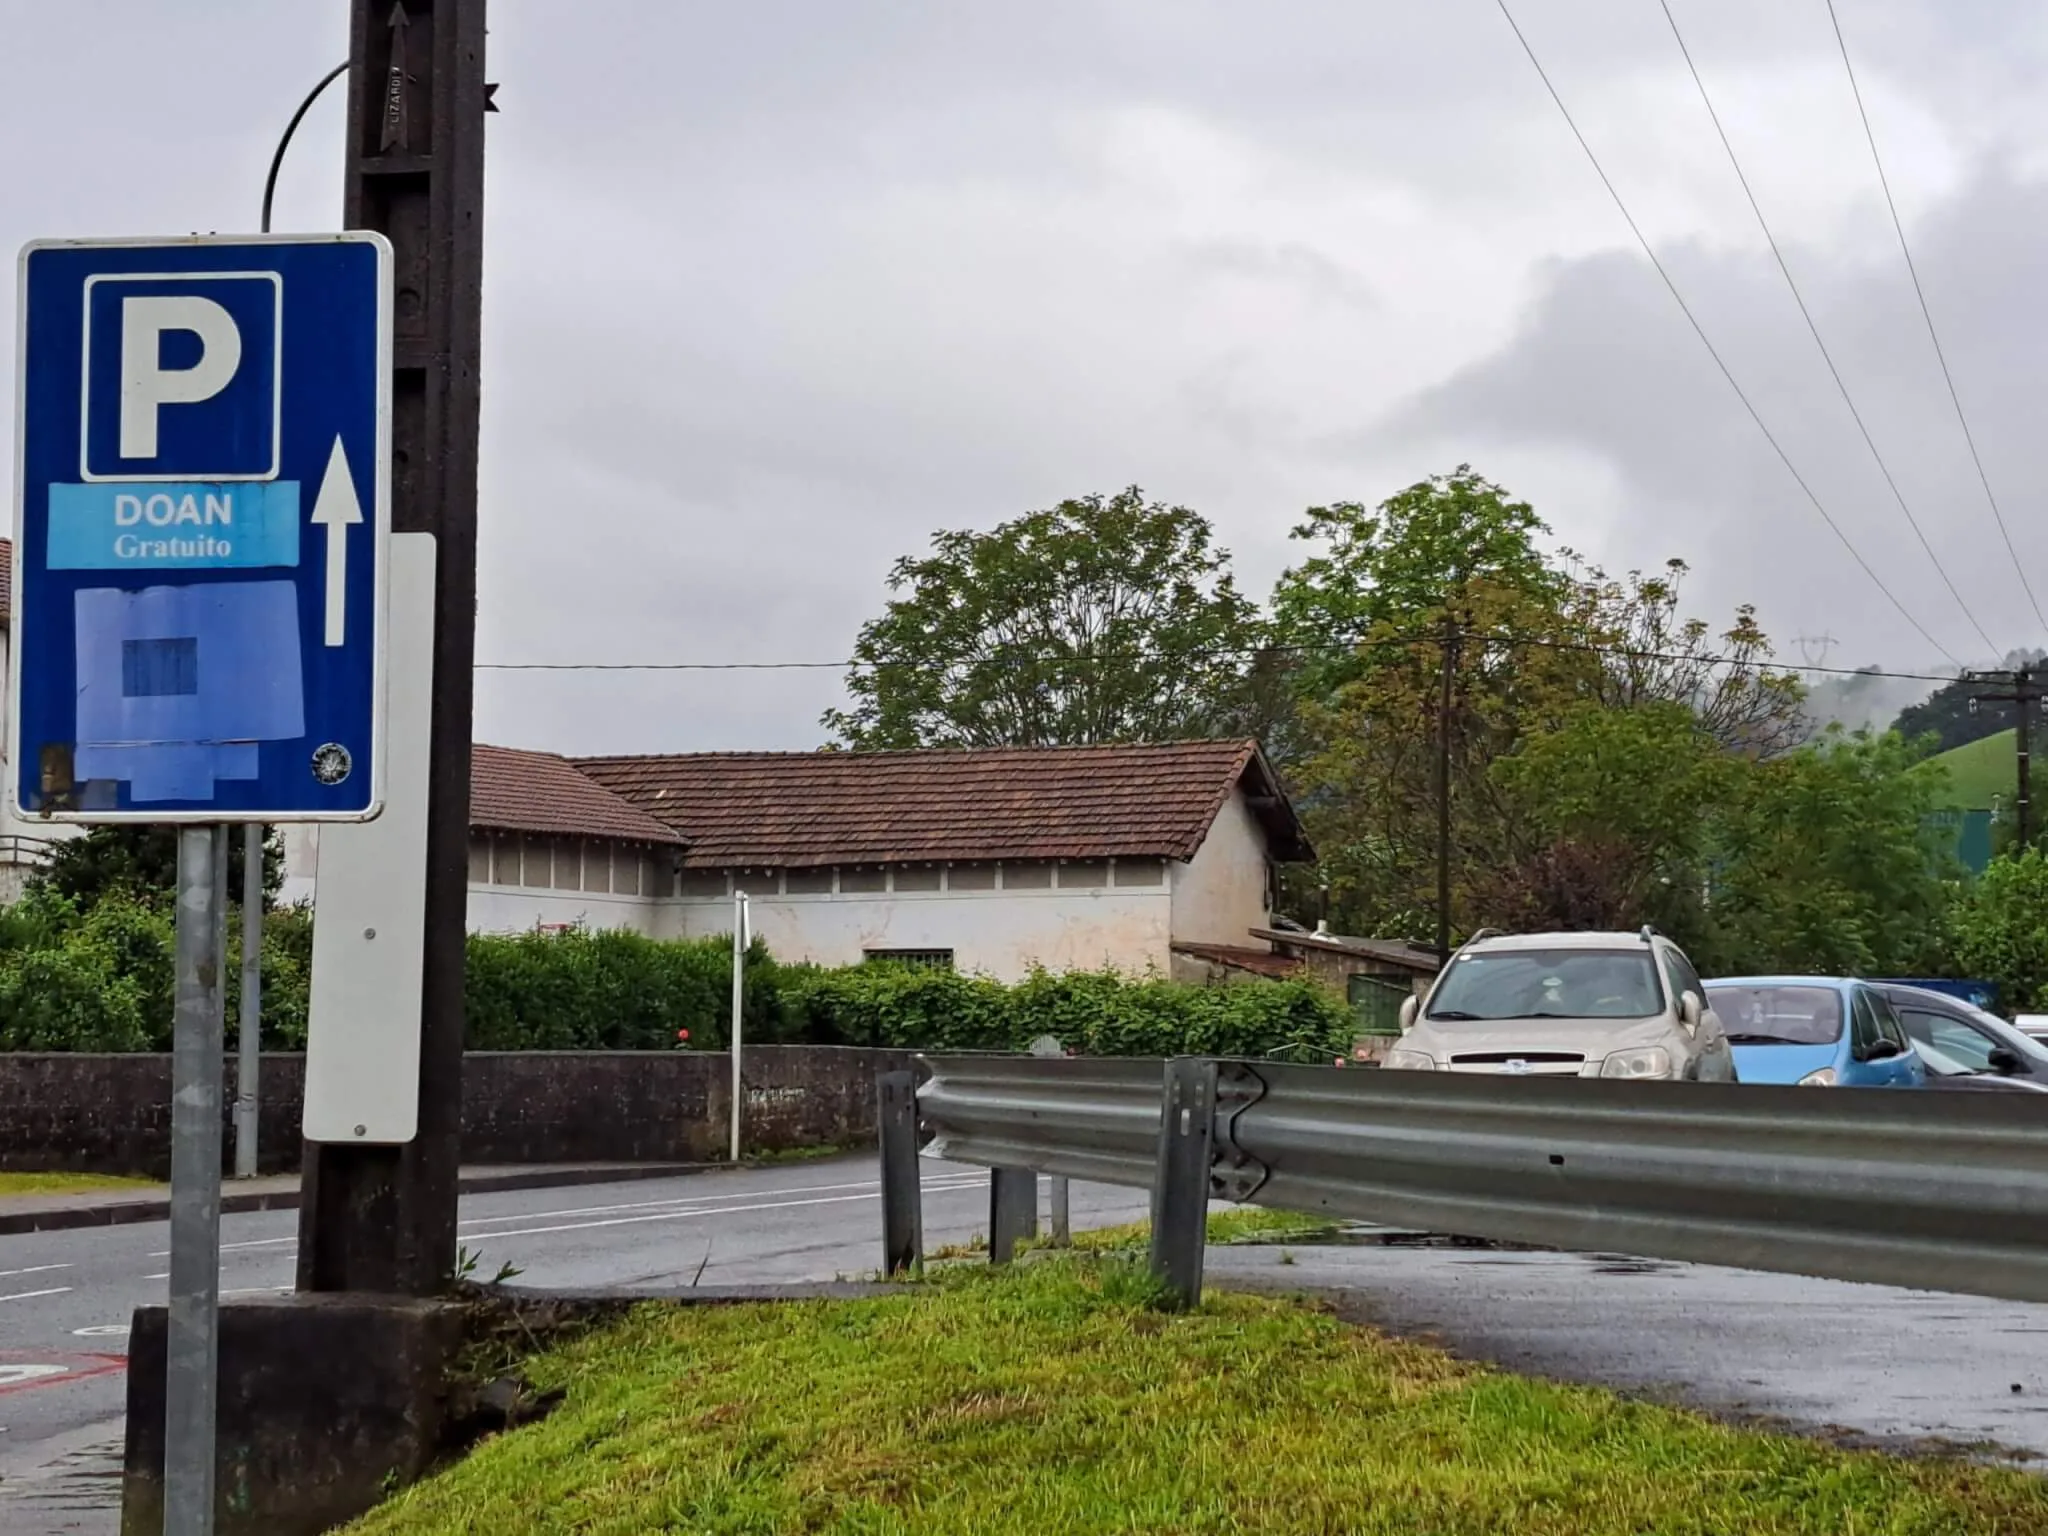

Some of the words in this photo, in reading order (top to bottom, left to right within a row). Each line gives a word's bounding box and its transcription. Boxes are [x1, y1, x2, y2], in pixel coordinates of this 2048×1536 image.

[119, 296, 242, 459] P
[114, 493, 232, 526] DOAN
[113, 533, 232, 558] Gratuito
